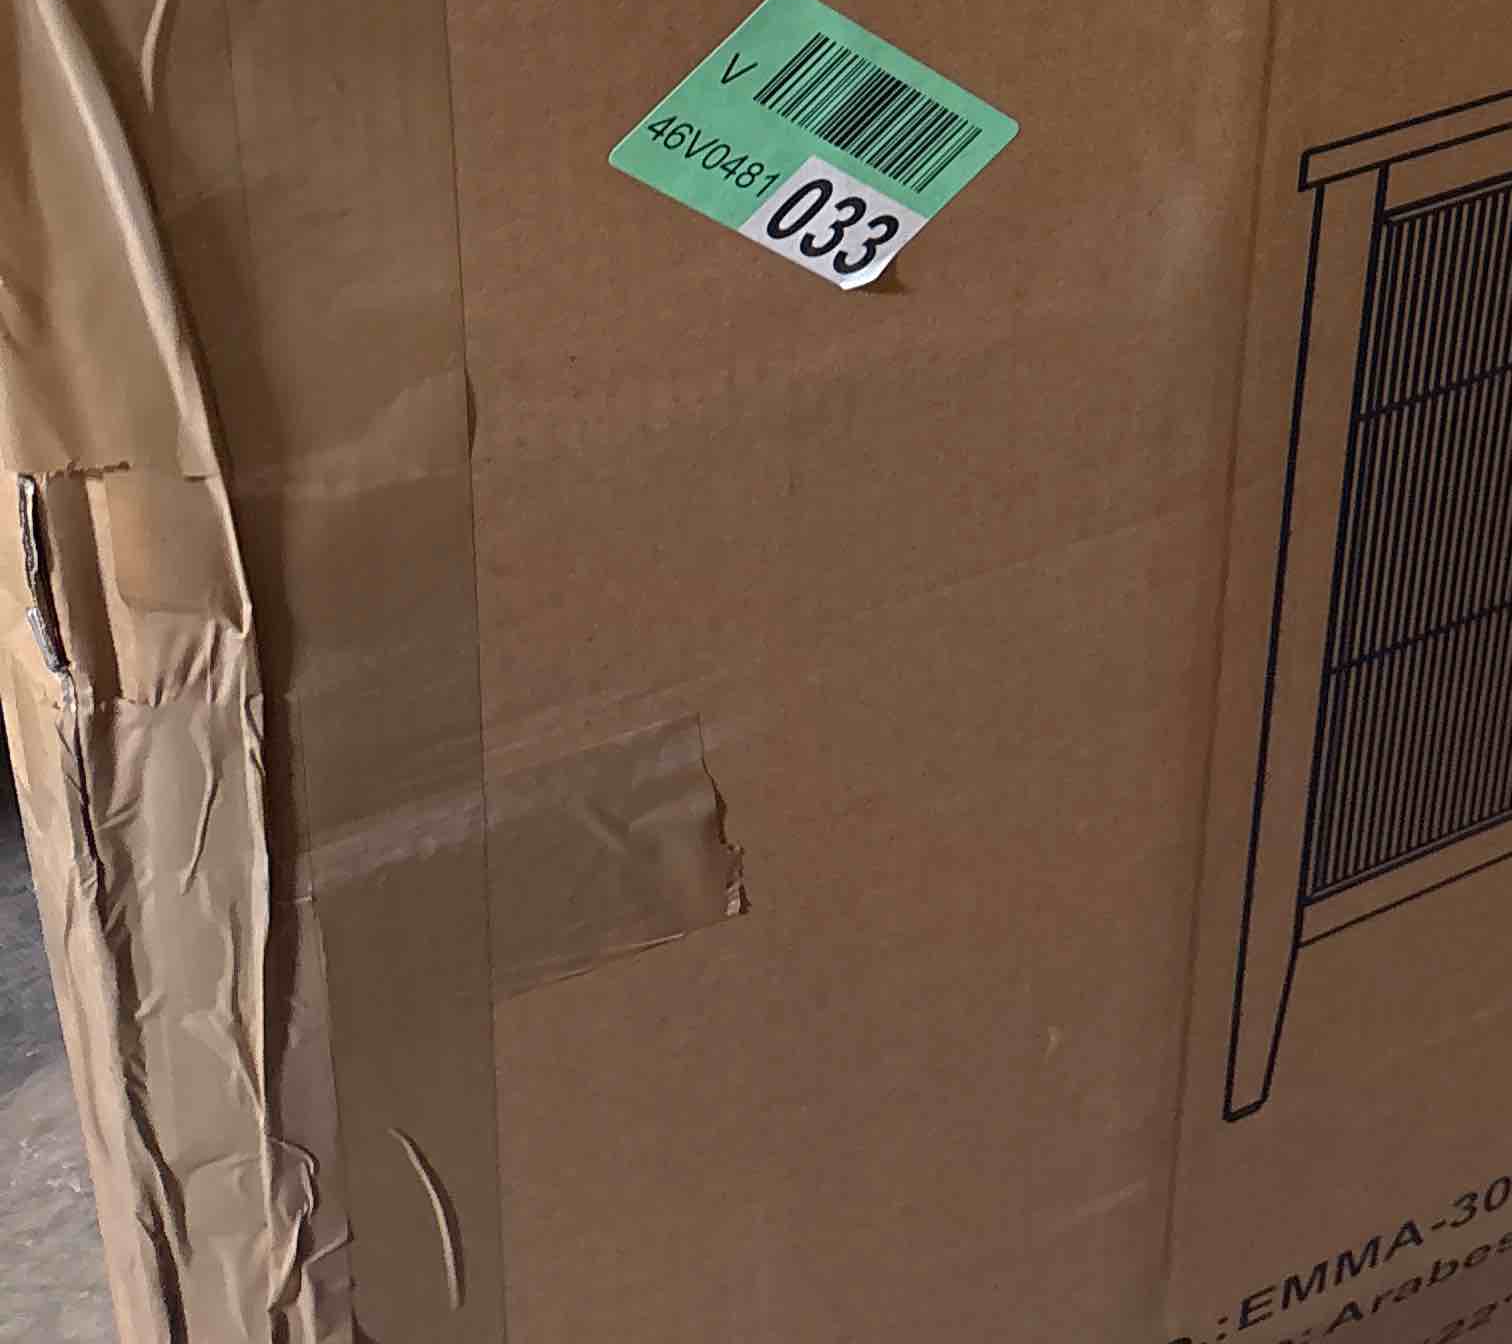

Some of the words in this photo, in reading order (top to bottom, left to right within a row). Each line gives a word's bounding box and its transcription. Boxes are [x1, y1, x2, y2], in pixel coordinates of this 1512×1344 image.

[720, 52, 758, 85] V
[647, 115, 781, 198] 46V0481
[766, 178, 900, 274] 033
